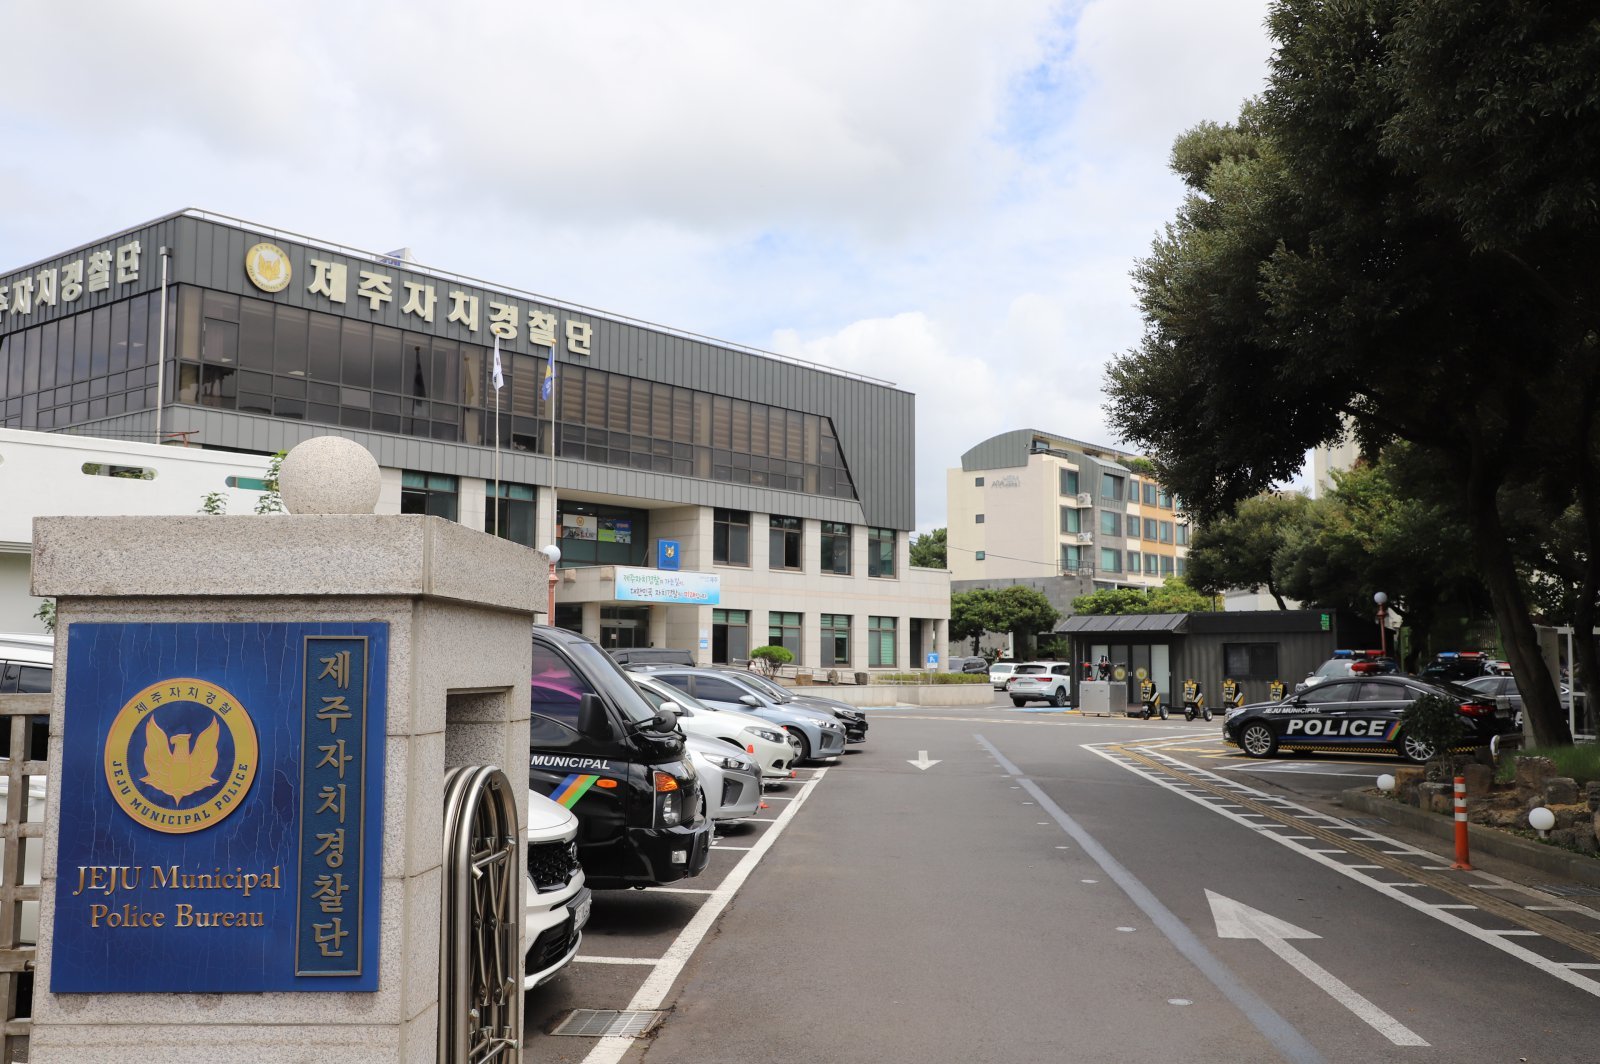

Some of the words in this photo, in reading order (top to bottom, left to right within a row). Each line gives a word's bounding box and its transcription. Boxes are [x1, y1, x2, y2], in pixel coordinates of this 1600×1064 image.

[307, 258, 593, 356] 제주자치경찰단
[134, 686, 232, 716] 제주자치경찰
[1286, 719, 1387, 736] POLICE
[530, 755, 610, 770] MUNICIPAL
[112, 760, 131, 796] JEJU
[130, 798, 211, 825] MUNICIPAL
[214, 763, 248, 811] POLICE
[310, 649, 354, 958] 제주자치경찰단
[72, 865, 143, 896] JEJU
[150, 865, 281, 898] Municipal
[89, 903, 165, 929] Police
[174, 903, 265, 928] Bureau
